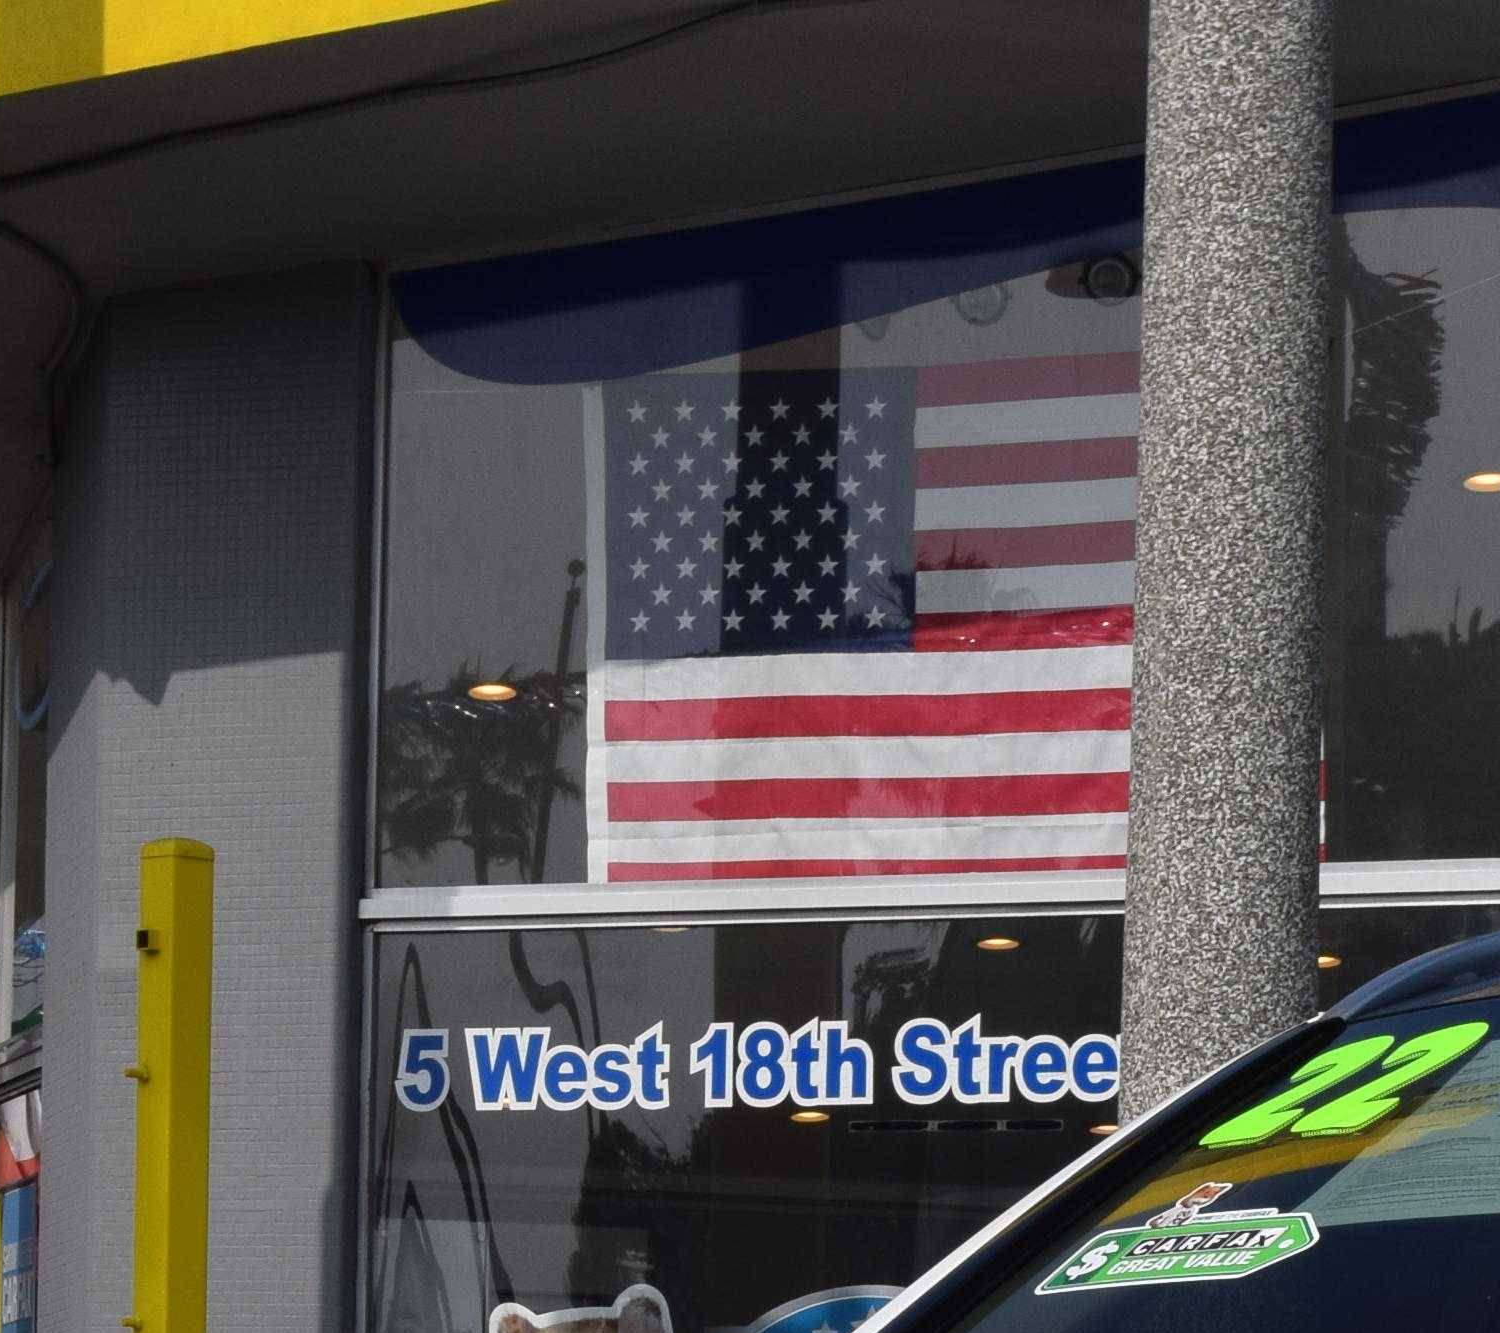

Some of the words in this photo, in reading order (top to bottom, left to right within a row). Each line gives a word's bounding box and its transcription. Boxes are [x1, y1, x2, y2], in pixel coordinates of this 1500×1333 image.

[397, 1028, 450, 1111] 5
[464, 1021, 670, 1111] West
[690, 1016, 874, 1108] 18th
[890, 1013, 1122, 1106] Stree
[1198, 1021, 1491, 1151] 22
[1106, 1254, 1180, 1277] GREAT
[1183, 1249, 1261, 1273] VALUE
[1130, 1230, 1277, 1257] CARFAX
